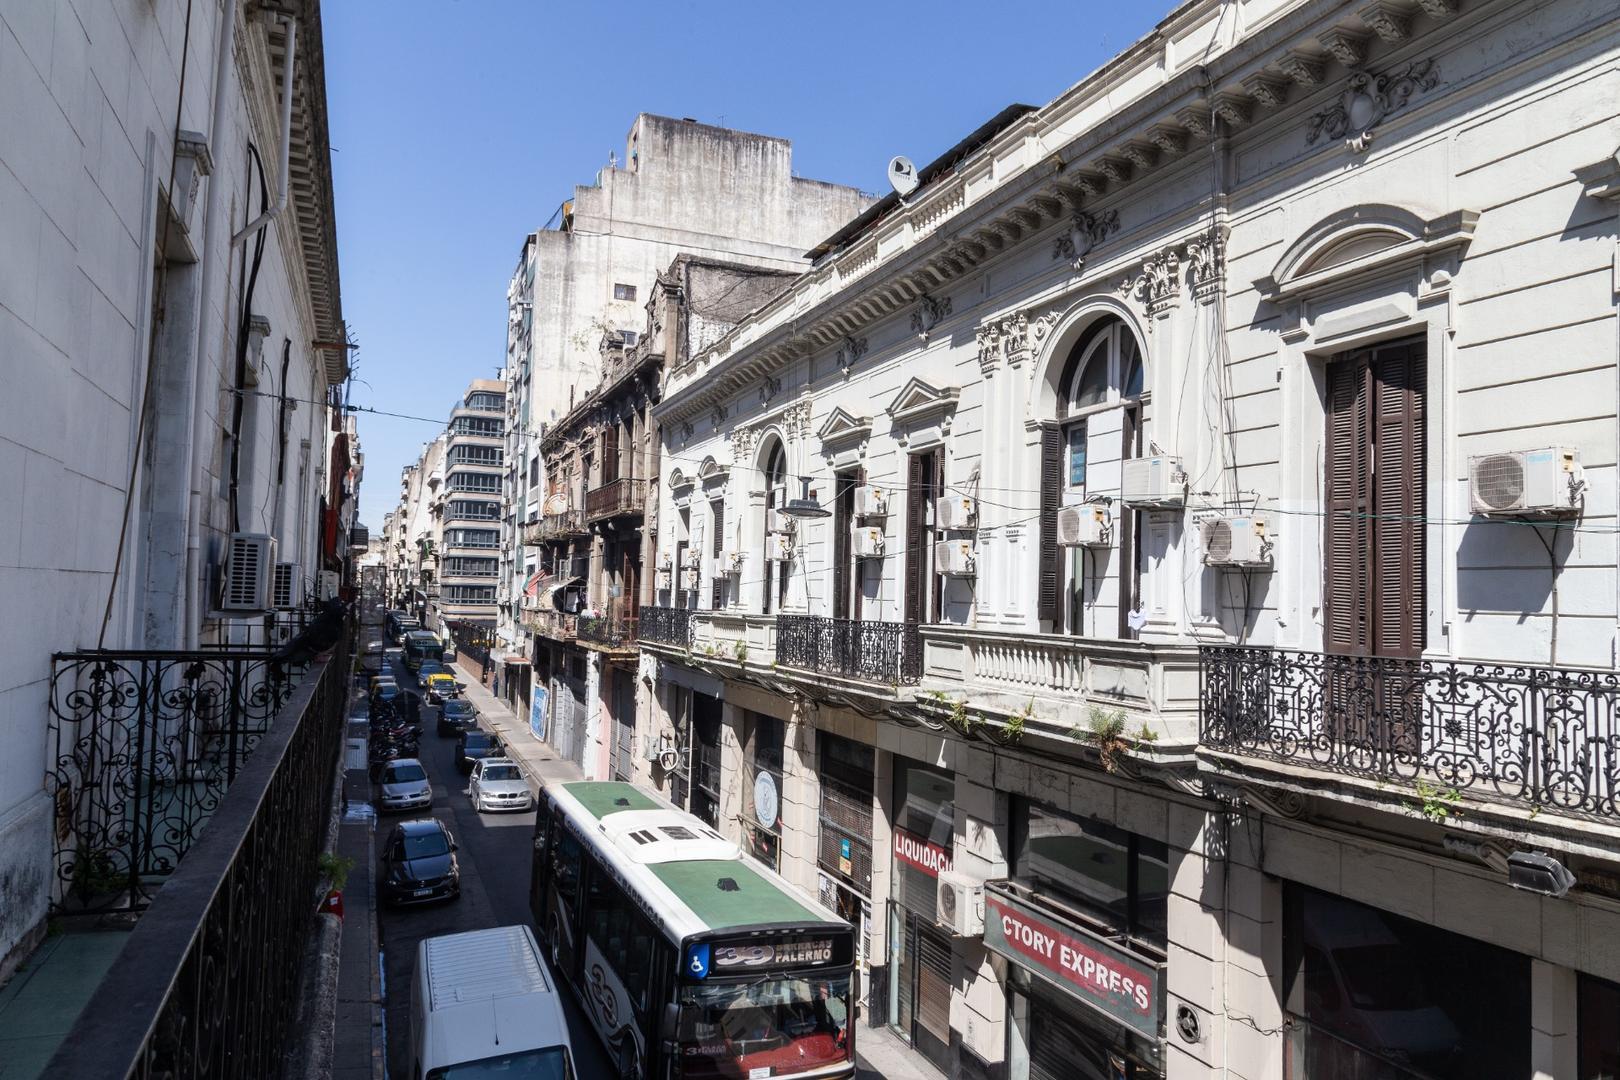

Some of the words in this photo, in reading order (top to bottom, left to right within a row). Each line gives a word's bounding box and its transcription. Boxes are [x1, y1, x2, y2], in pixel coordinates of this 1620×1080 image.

[715, 945, 775, 966] 39
[775, 948, 832, 963] PALERMO
[1002, 915, 1056, 959] CTORY
[1060, 944, 1149, 1010] EXPRESS
